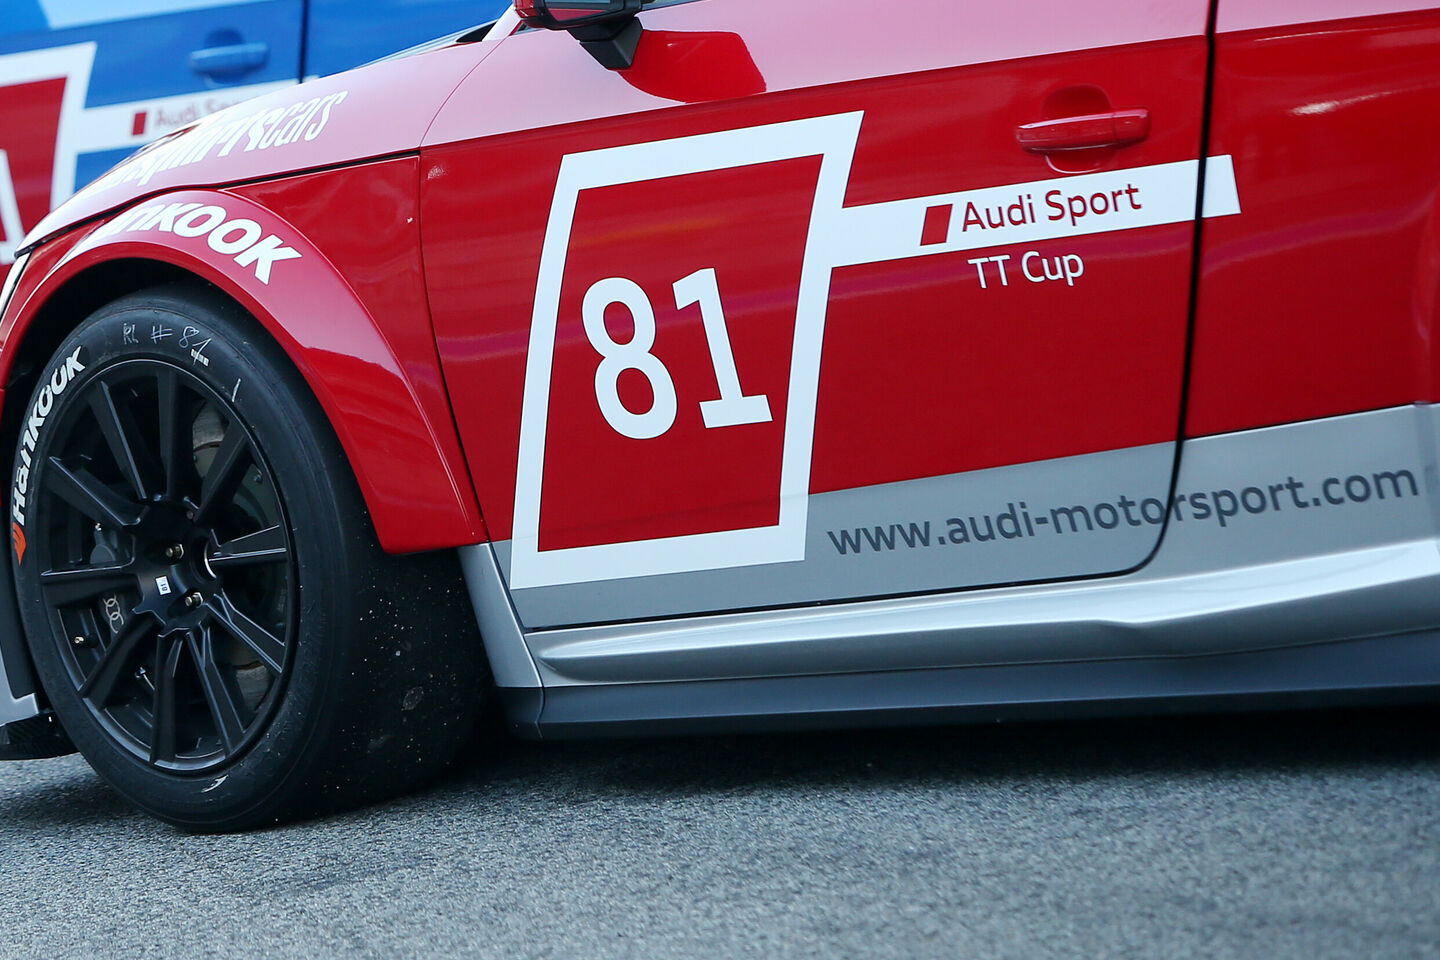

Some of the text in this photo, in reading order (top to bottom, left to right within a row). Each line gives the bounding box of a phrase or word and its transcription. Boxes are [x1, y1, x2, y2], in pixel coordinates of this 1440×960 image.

[962, 183, 1142, 232] Audi Sport
[967, 250, 1085, 289] TT Cup
[581, 267, 773, 441] 81
[827, 467, 1419, 556] www.audi-motorsport.com
